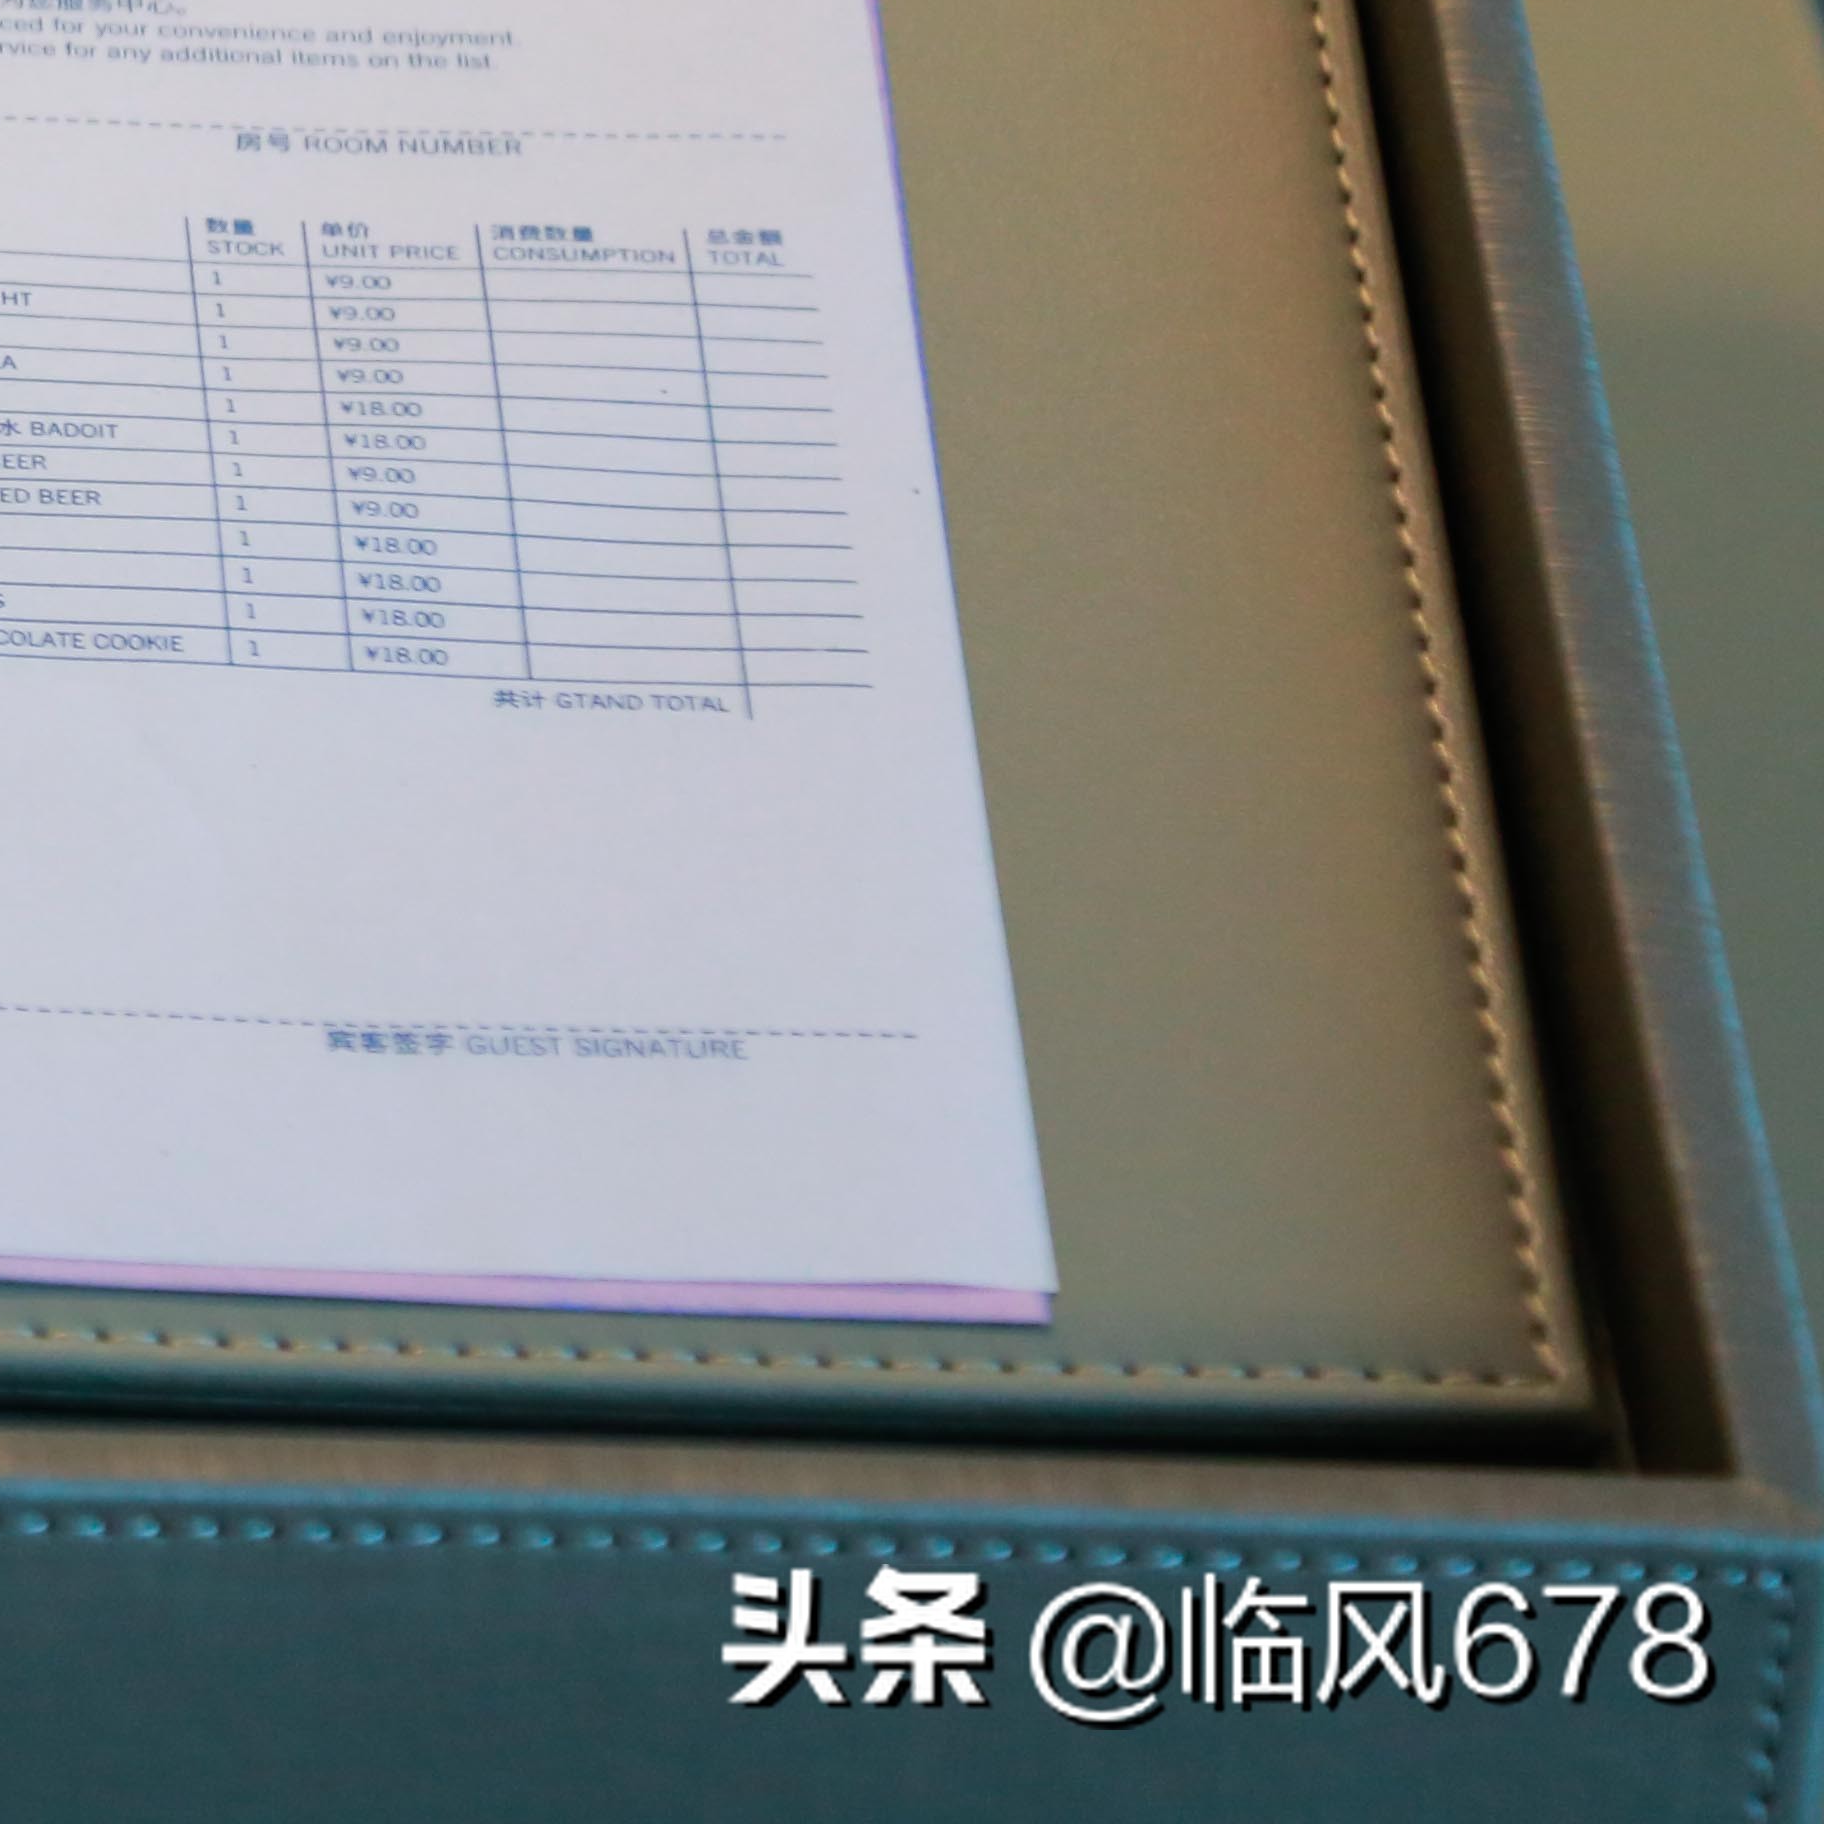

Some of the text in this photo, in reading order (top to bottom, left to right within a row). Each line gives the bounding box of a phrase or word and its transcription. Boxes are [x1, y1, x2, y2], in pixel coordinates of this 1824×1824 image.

[53, 16, 85, 36] for
[95, 21, 149, 40] your
[157, 22, 318, 44] convenience
[325, 27, 374, 46] and
[65, 40, 99, 60] for
[105, 45, 153, 66] any
[159, 45, 284, 66] additional
[291, 48, 360, 69] items
[368, 52, 400, 69] on
[408, 51, 449, 70] the
[303, 135, 389, 155] ROOM
[397, 137, 523, 157] NUMBER
[205, 217, 256, 237] 数量
[207, 240, 285, 258] STOCK
[321, 243, 459, 261] UNIT PRICE
[493, 245, 677, 265] CONSUMPTION
[708, 249, 785, 267] TOTAL
[29, 420, 120, 439] BADOIT
[39, 488, 103, 507] BEER
[93, 631, 184, 653] COOKIE
[493, 688, 731, 714] 共计 GTAND TOTAL
[464, 1035, 565, 1058] GUEST
[572, 1037, 750, 1062] SIGNATURE
